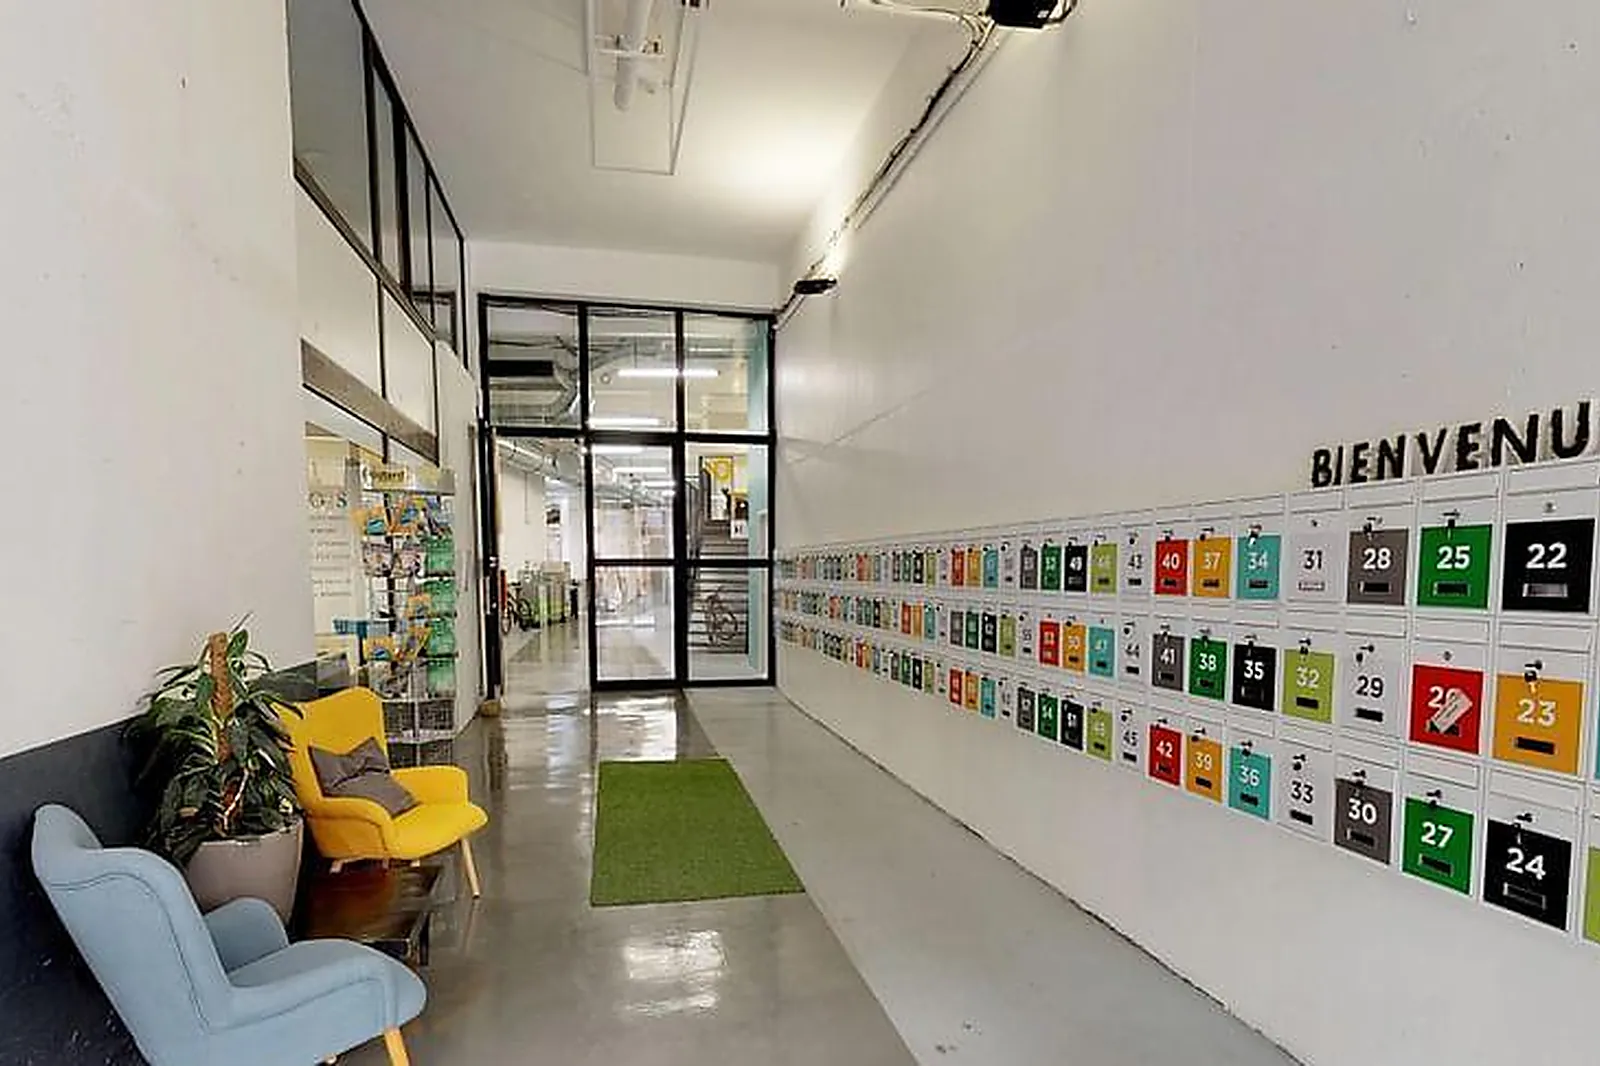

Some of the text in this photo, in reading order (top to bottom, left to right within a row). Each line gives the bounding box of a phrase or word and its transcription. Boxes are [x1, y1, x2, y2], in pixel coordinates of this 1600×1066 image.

[1311, 401, 1591, 488] BIENVENU
[1161, 553, 1180, 570] 40
[1203, 552, 1221, 571] 37
[1248, 551, 1268, 571] 34
[1303, 550, 1322, 570] 31
[1363, 548, 1391, 570] 28
[1436, 546, 1470, 569] 25
[1526, 542, 1568, 569] 22
[1160, 648, 1175, 665] 41
[1199, 653, 1217, 671] 38
[1244, 660, 1265, 680] 35
[1296, 666, 1320, 688] 32
[1356, 675, 1384, 698] 29
[1517, 699, 1556, 726] 23
[1156, 741, 1173, 758] 42
[1195, 752, 1212, 770] 39
[1239, 765, 1260, 787] 36
[1291, 780, 1314, 804] 33
[1348, 798, 1377, 824] 30
[1420, 822, 1453, 848] 27
[1506, 848, 1546, 880] 24
